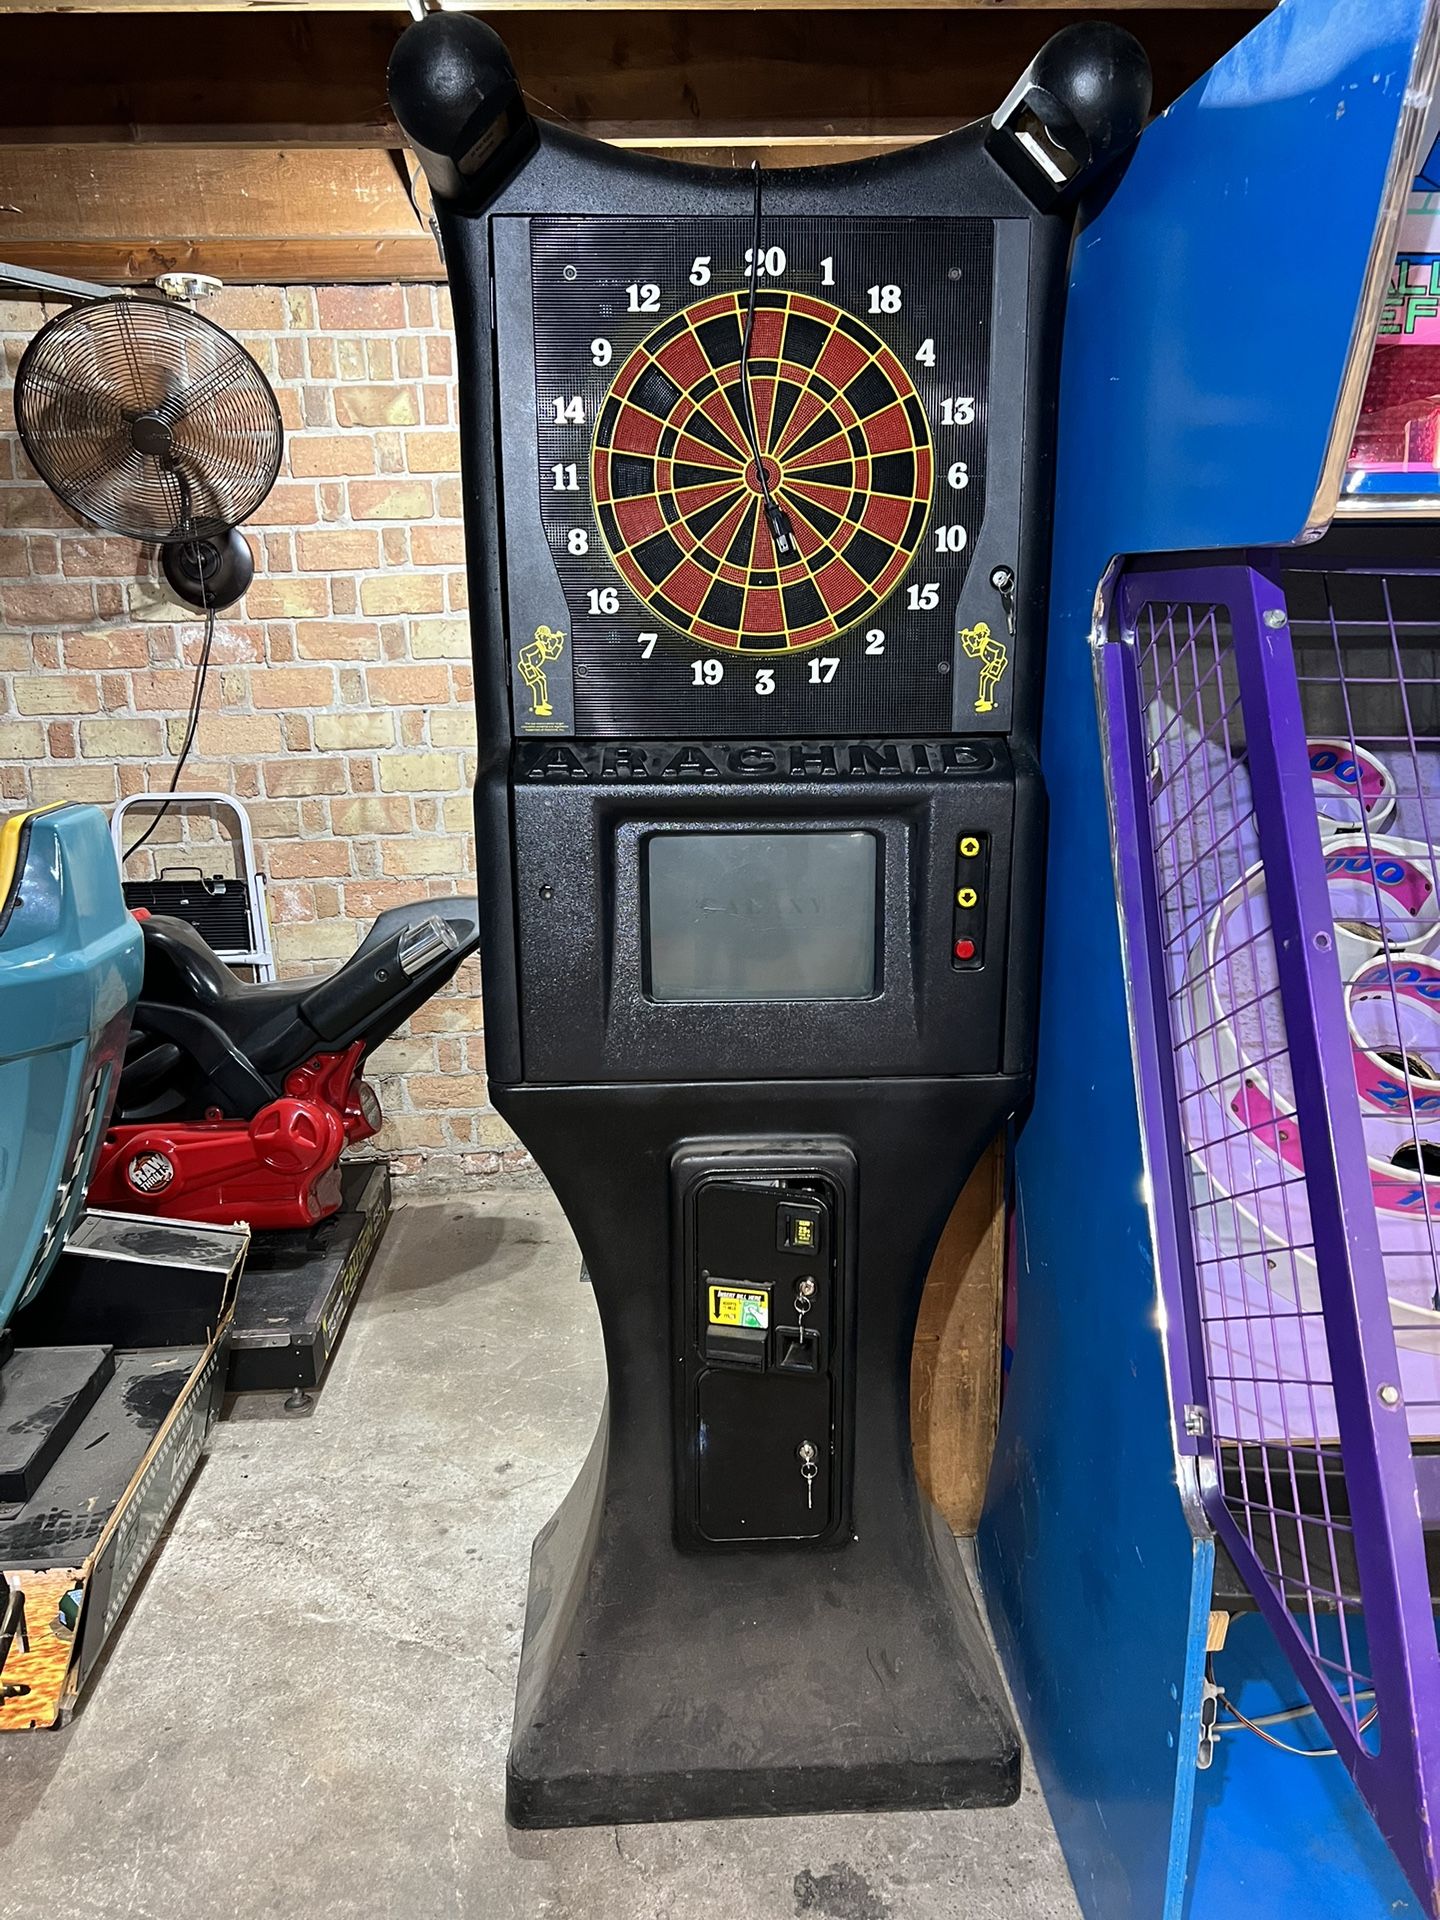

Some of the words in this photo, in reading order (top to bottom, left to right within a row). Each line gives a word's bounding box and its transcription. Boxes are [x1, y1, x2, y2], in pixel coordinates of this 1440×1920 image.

[689, 256, 711, 286] 5
[744, 246, 787, 277] 20
[821, 257, 836, 285] 1
[626, 284, 661, 312] 12
[867, 285, 902, 314] 18
[590, 338, 612, 367] 9
[915, 339, 936, 367] 4
[552, 397, 586, 424] 14
[940, 398, 975, 425] 13
[551, 464, 580, 491] 11
[947, 462, 968, 489] 6
[567, 528, 589, 555] 8
[935, 525, 967, 552] 10
[587, 587, 620, 615] 16
[907, 583, 940, 611] 15
[637, 632, 659, 659] 7
[865, 629, 885, 655] 2
[691, 659, 724, 687] 19
[755, 669, 776, 695] 3
[808, 658, 840, 684] 17
[527, 745, 997, 777] ARACHNID
[132, 1153, 166, 1185] RAW
